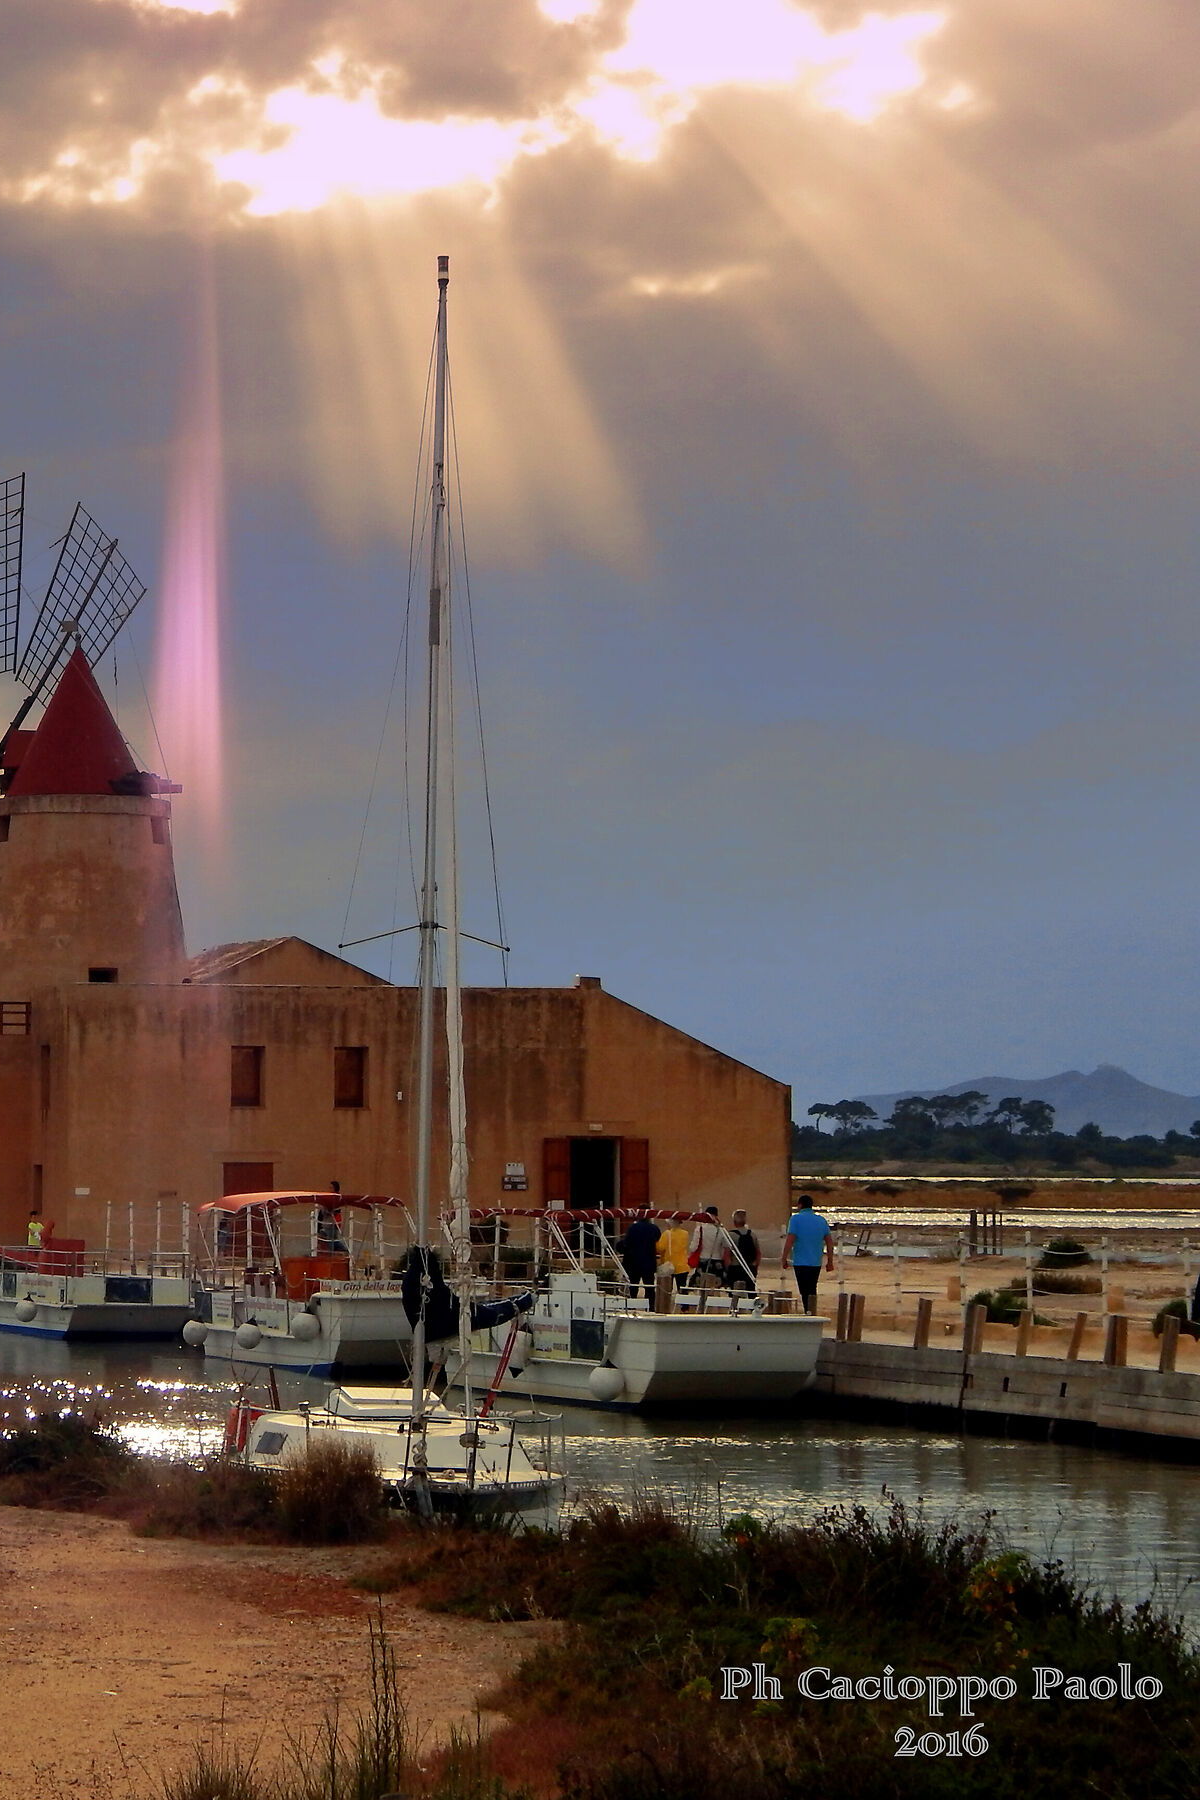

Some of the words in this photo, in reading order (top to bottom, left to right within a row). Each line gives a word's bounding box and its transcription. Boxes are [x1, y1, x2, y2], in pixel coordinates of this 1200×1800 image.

[343, 1281, 362, 1292] Giro
[363, 1280, 385, 1291] della
[386, 1281, 402, 1293] lag
